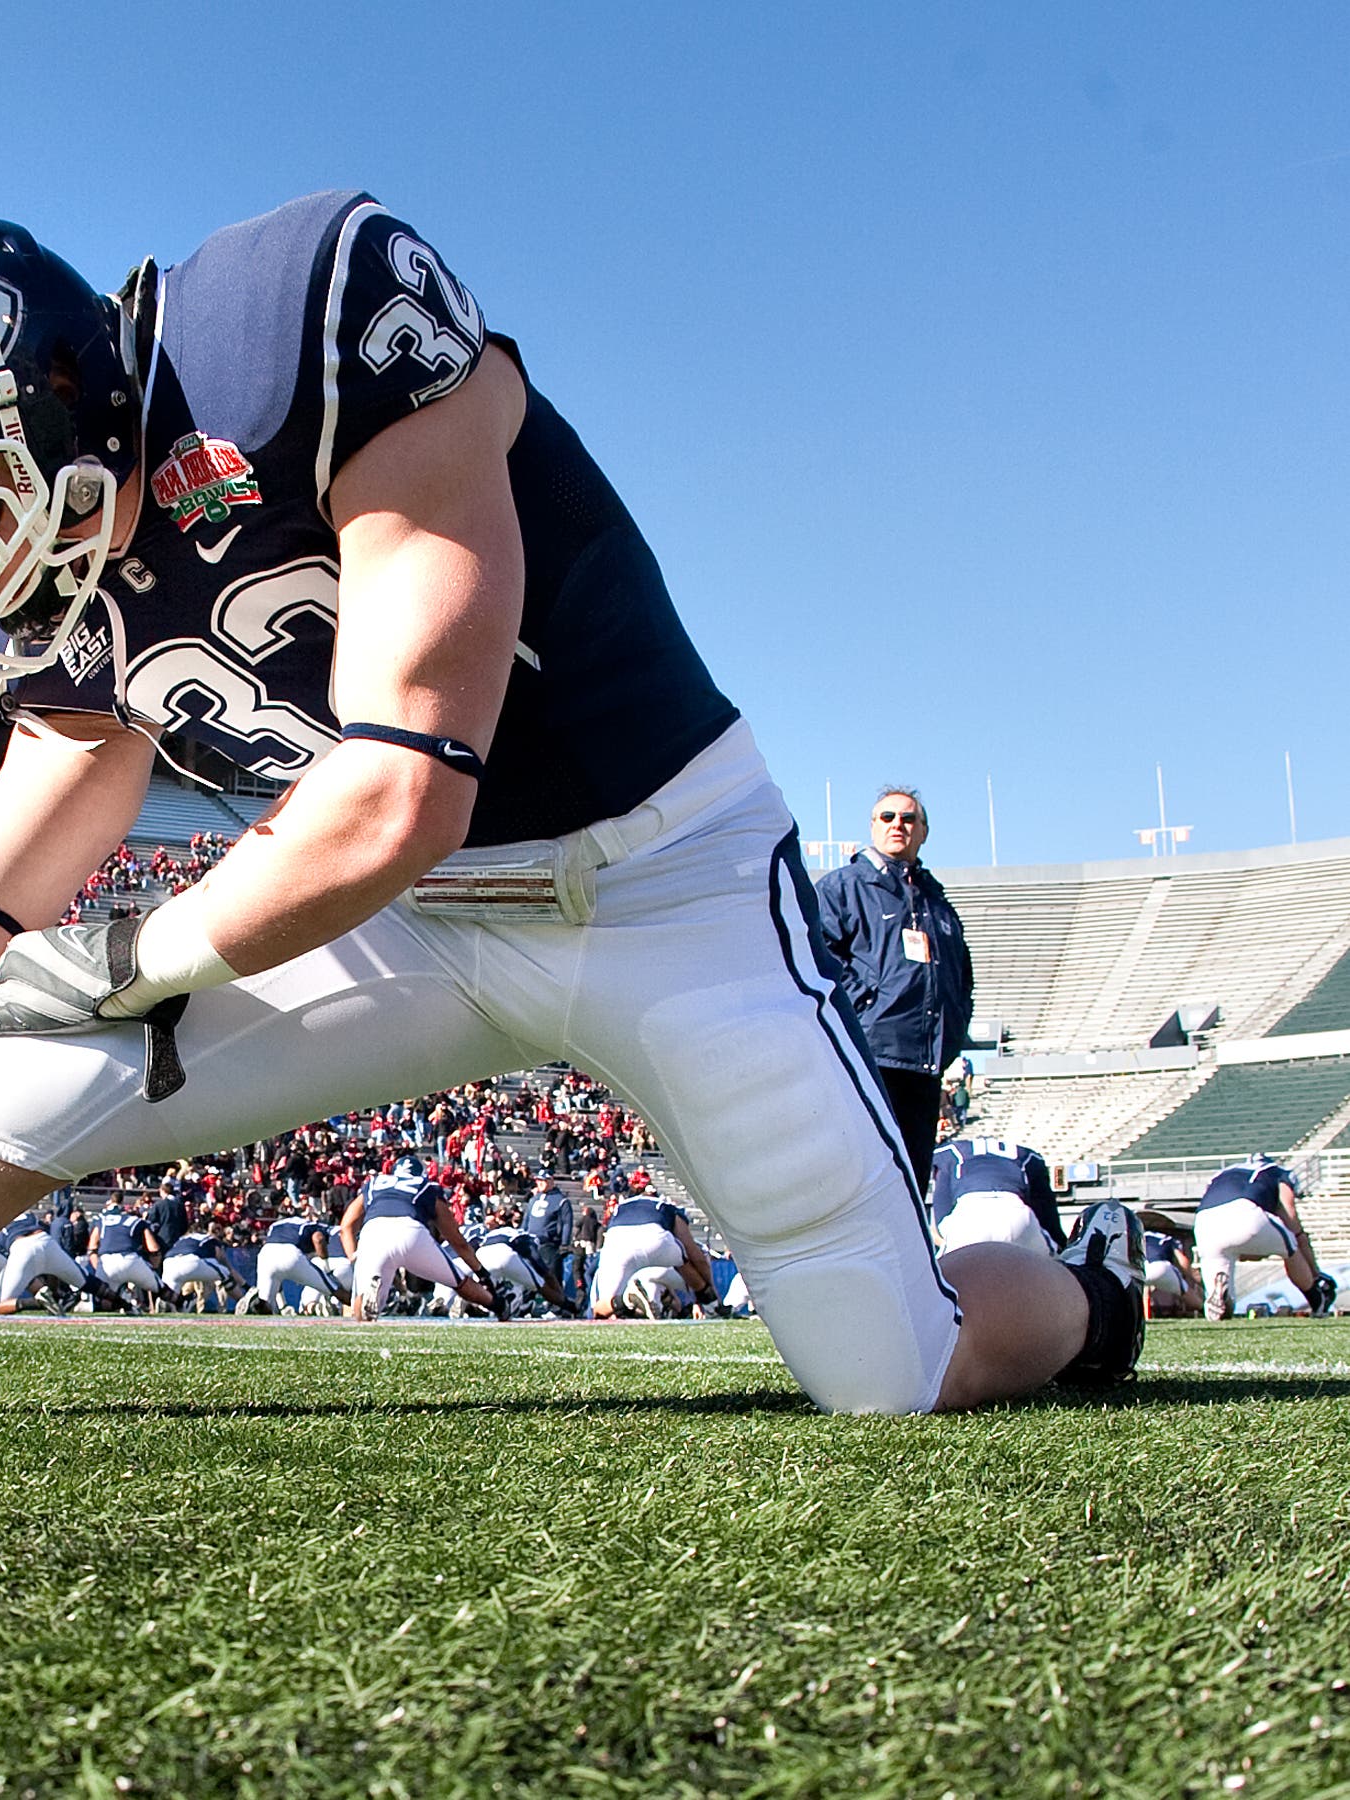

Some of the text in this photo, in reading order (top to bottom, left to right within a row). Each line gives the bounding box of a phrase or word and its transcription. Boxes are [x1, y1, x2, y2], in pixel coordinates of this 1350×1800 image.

[359, 231, 486, 409] 32
[178, 479, 249, 518] BOWL
[119, 557, 157, 593] C
[58, 621, 91, 662] BIG
[63, 626, 108, 679] EAST
